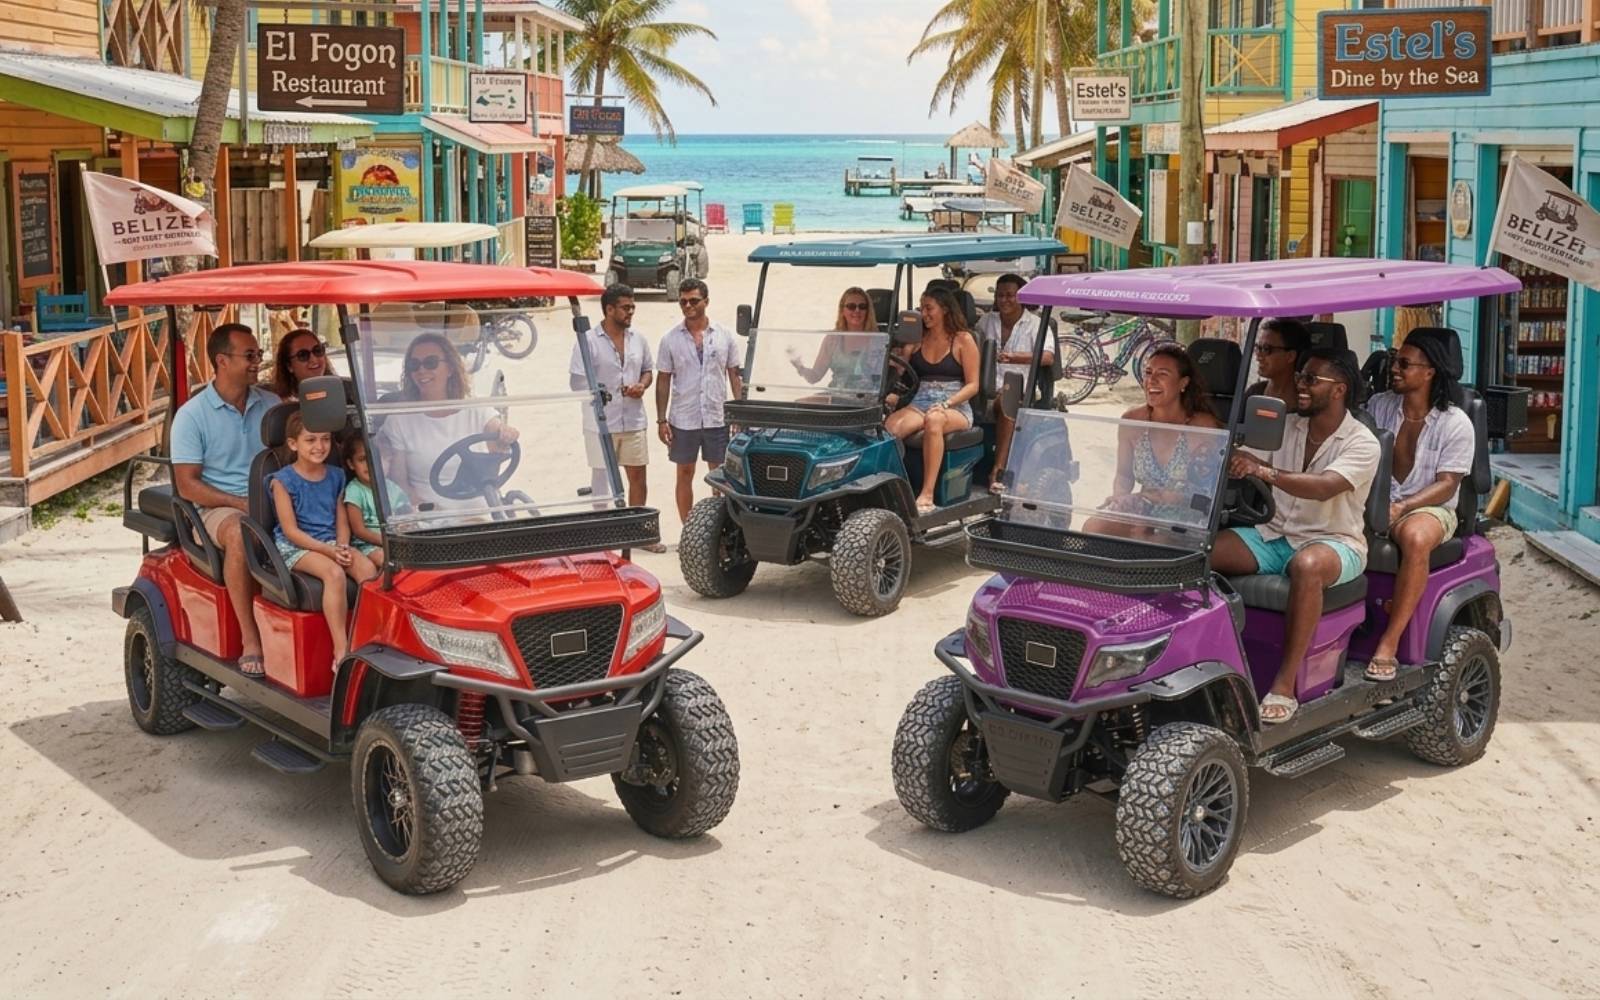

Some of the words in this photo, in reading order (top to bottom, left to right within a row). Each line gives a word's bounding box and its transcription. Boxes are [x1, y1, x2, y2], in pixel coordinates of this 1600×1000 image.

[266, 31, 296, 60] El
[310, 33, 396, 71] Fogon
[1334, 20, 1476, 62] Estel's
[272, 70, 386, 95] Restaurant
[1077, 82, 1126, 98] Estel's
[1331, 68, 1375, 87] Dine
[1381, 68, 1403, 90] by
[1409, 67, 1439, 85] the
[1445, 66, 1479, 85] Sea
